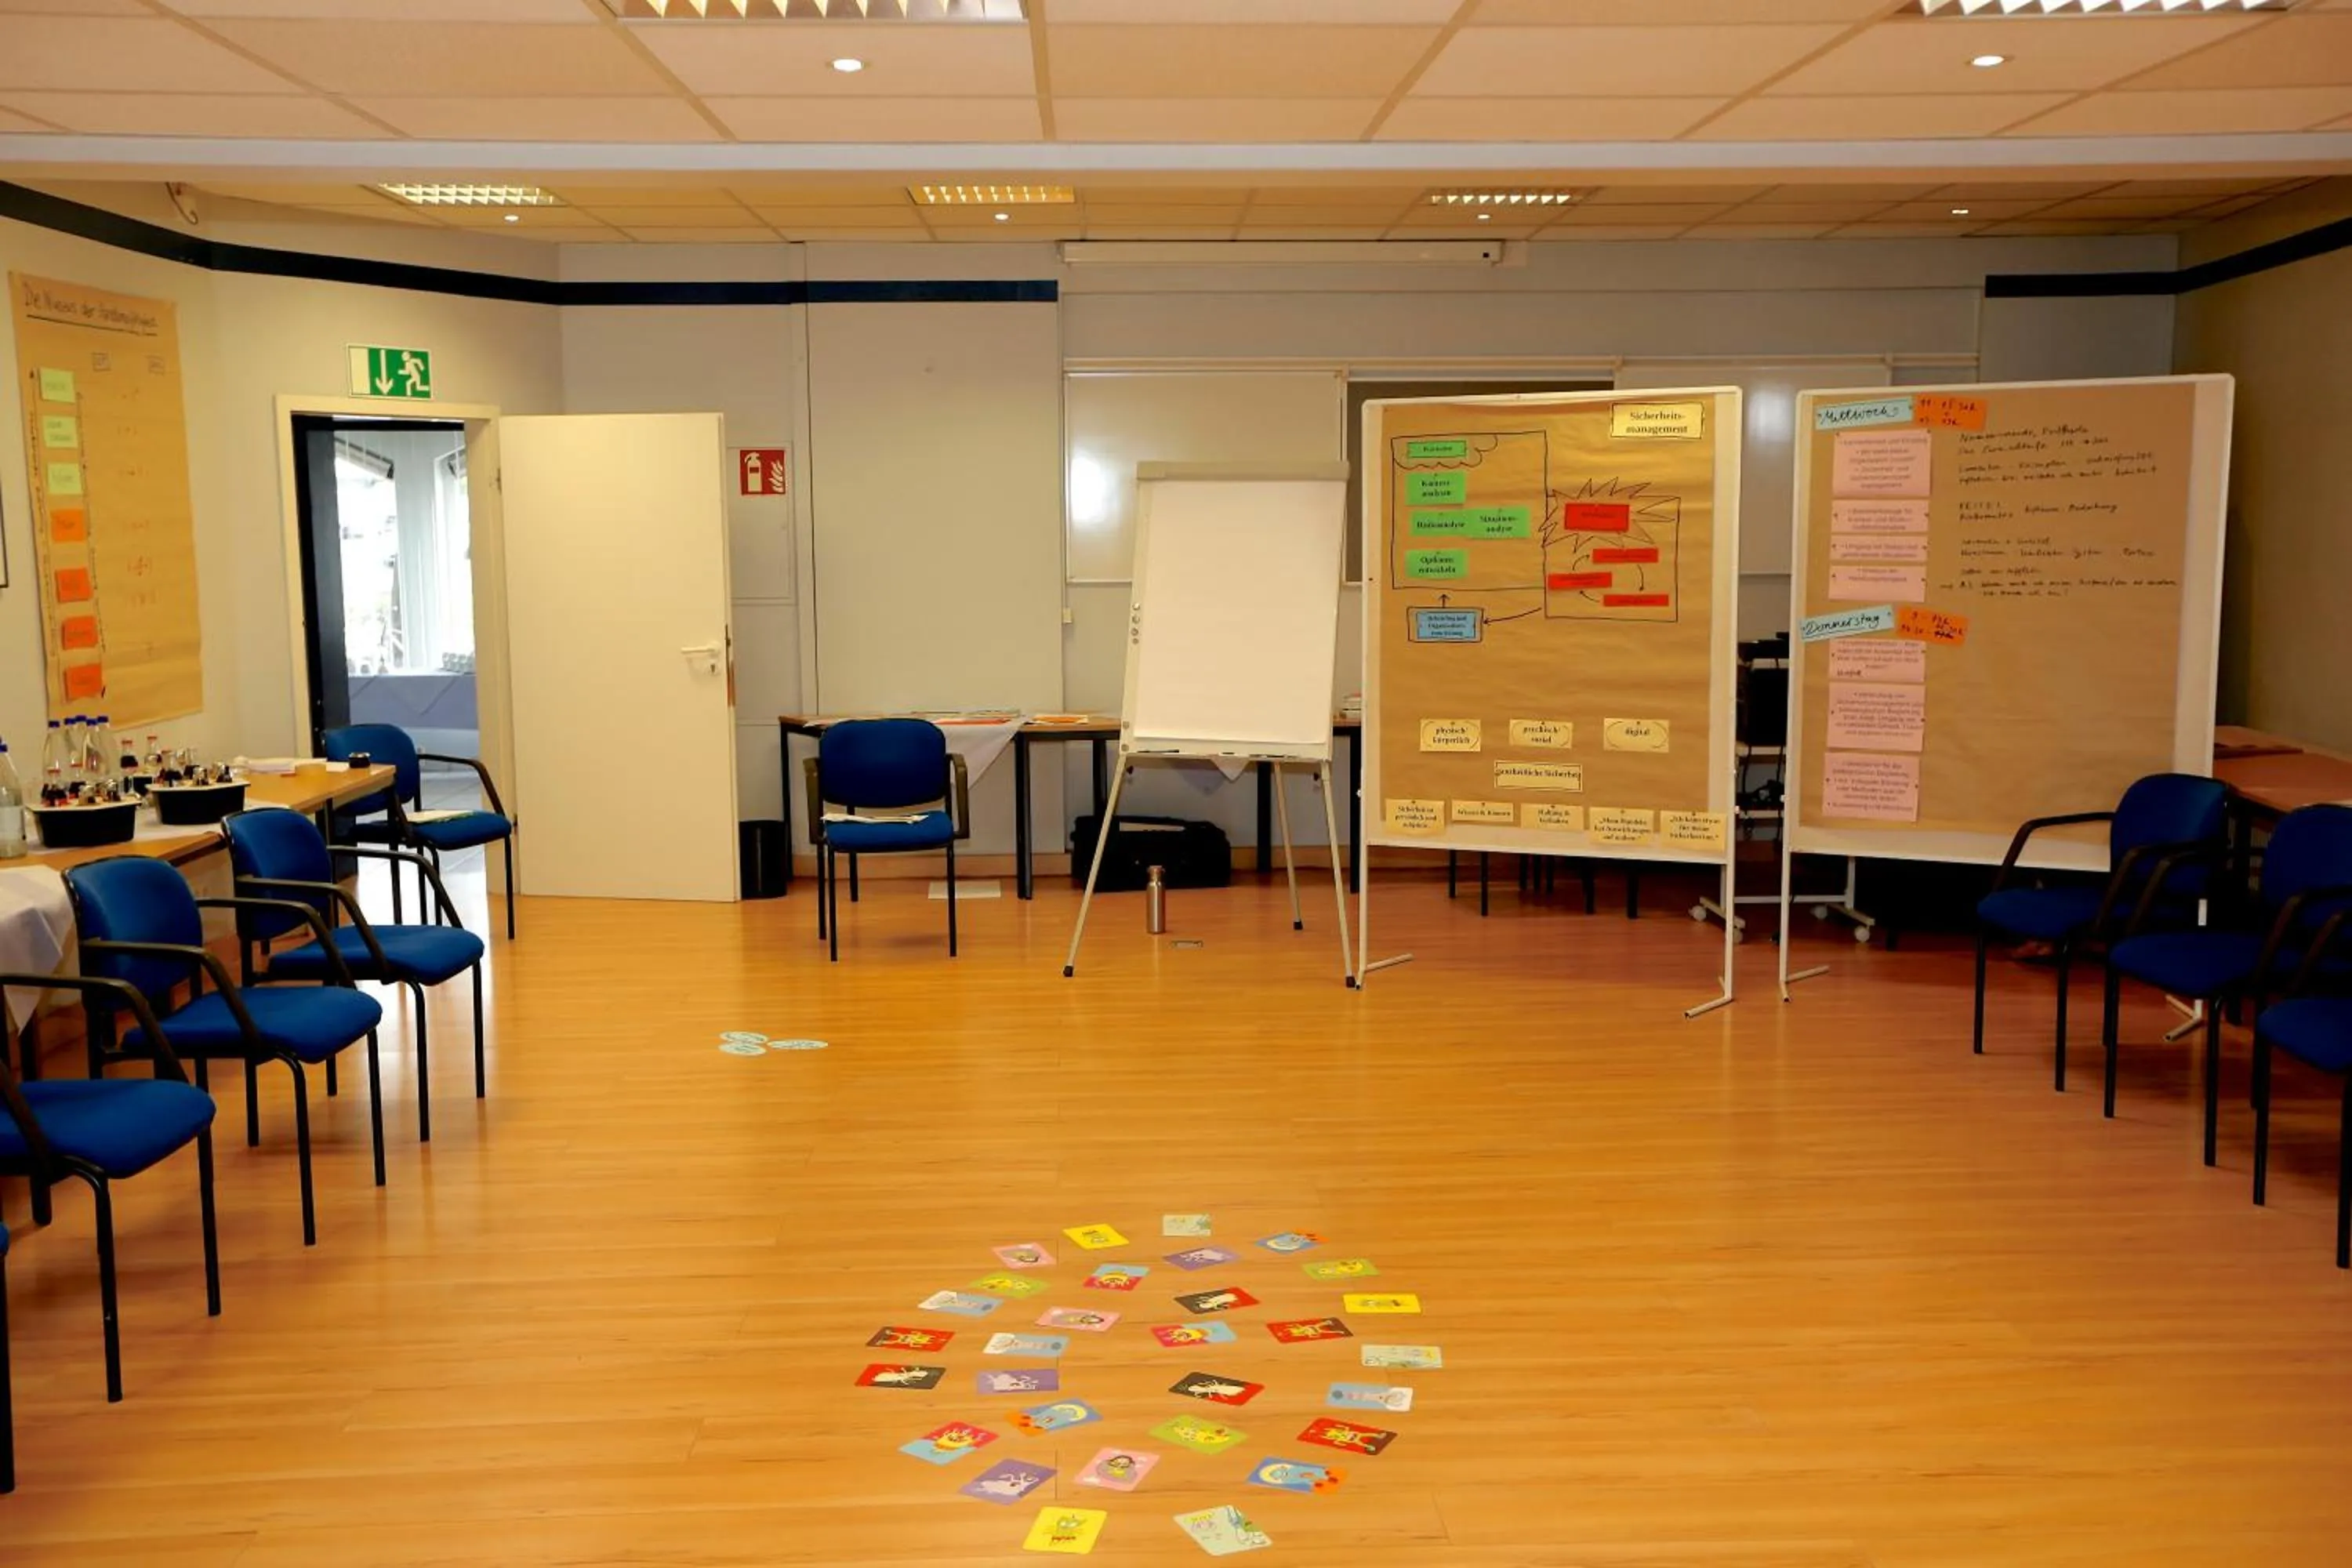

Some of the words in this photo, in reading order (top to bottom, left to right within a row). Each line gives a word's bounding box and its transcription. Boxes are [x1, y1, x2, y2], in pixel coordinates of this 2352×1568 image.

[1630, 411, 1686, 421] Sicherheits-
[1626, 426, 1688, 435] management
[1806, 613, 1880, 635] Donnerstag
[1625, 727, 1650, 737] digital
[1432, 735, 1471, 745] körperlich
